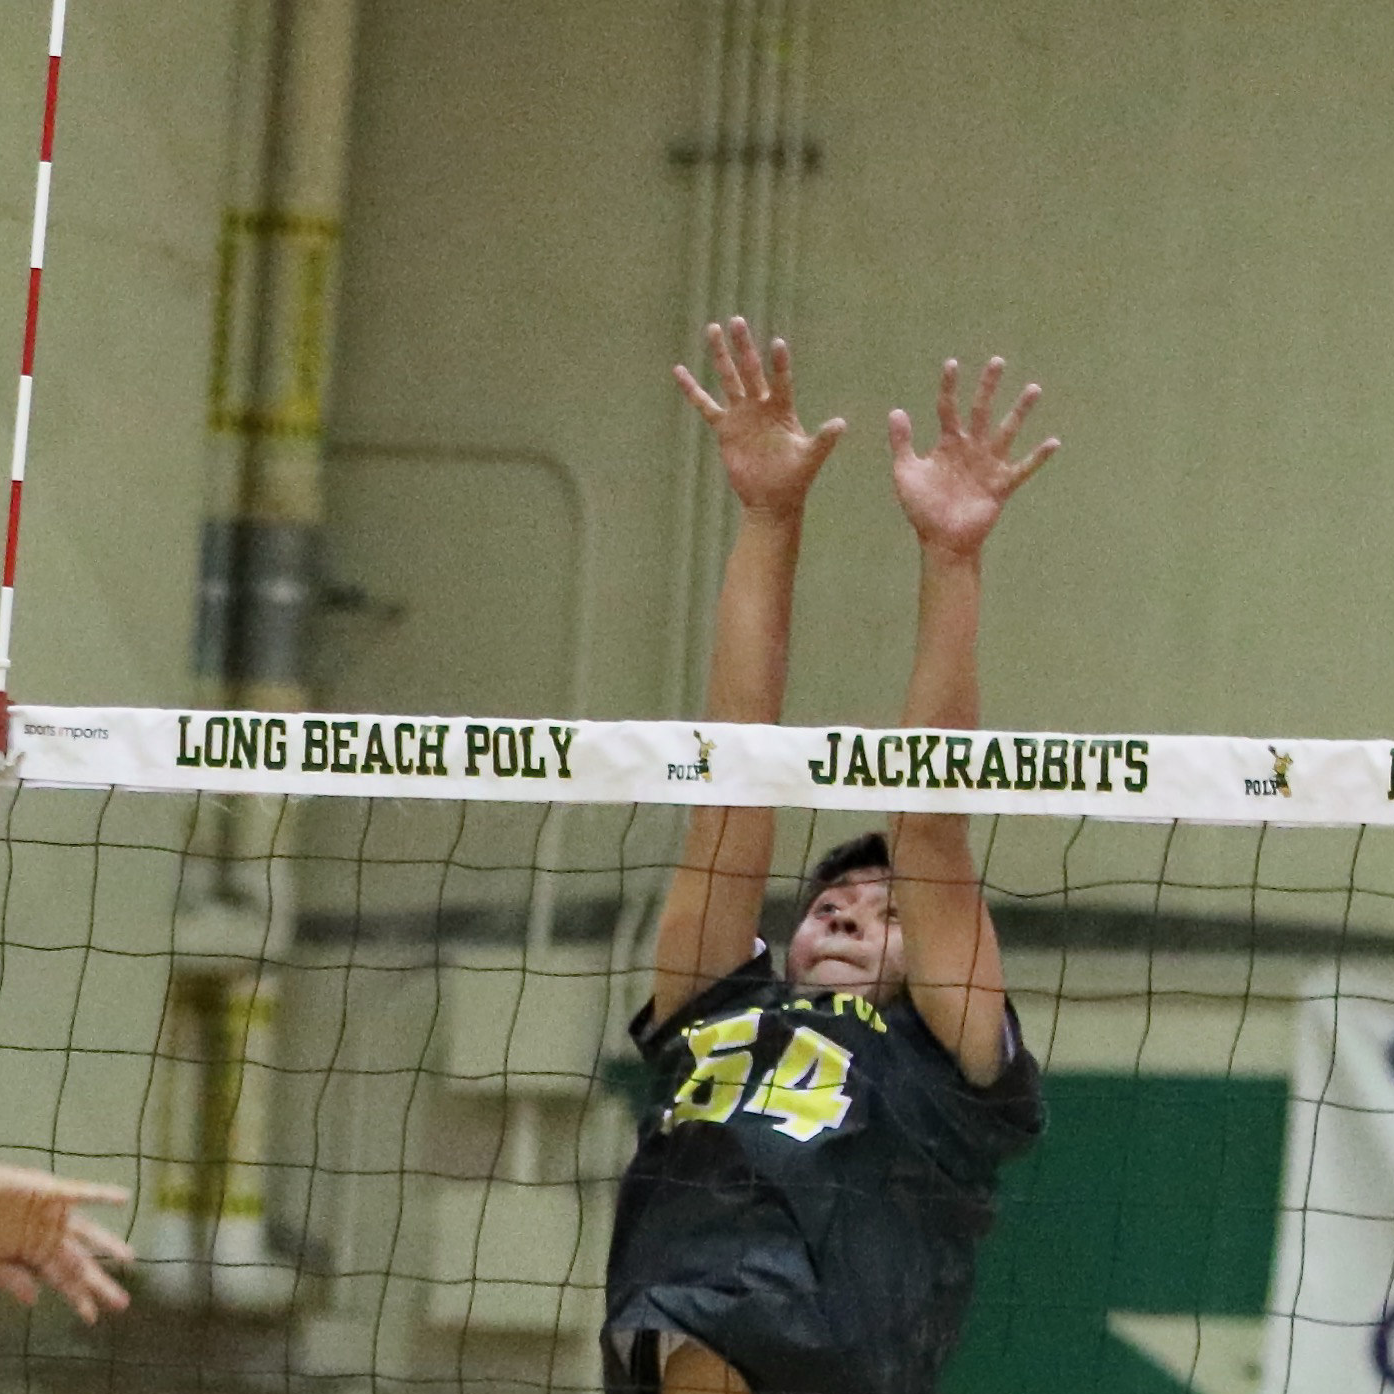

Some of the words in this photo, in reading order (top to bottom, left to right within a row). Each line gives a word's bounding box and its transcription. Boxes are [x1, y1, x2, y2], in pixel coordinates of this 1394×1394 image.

[176, 716, 287, 770] LONG
[301, 720, 450, 777] BEACH
[465, 725, 577, 780] POLY
[808, 732, 1149, 793] JACKRABBITS
